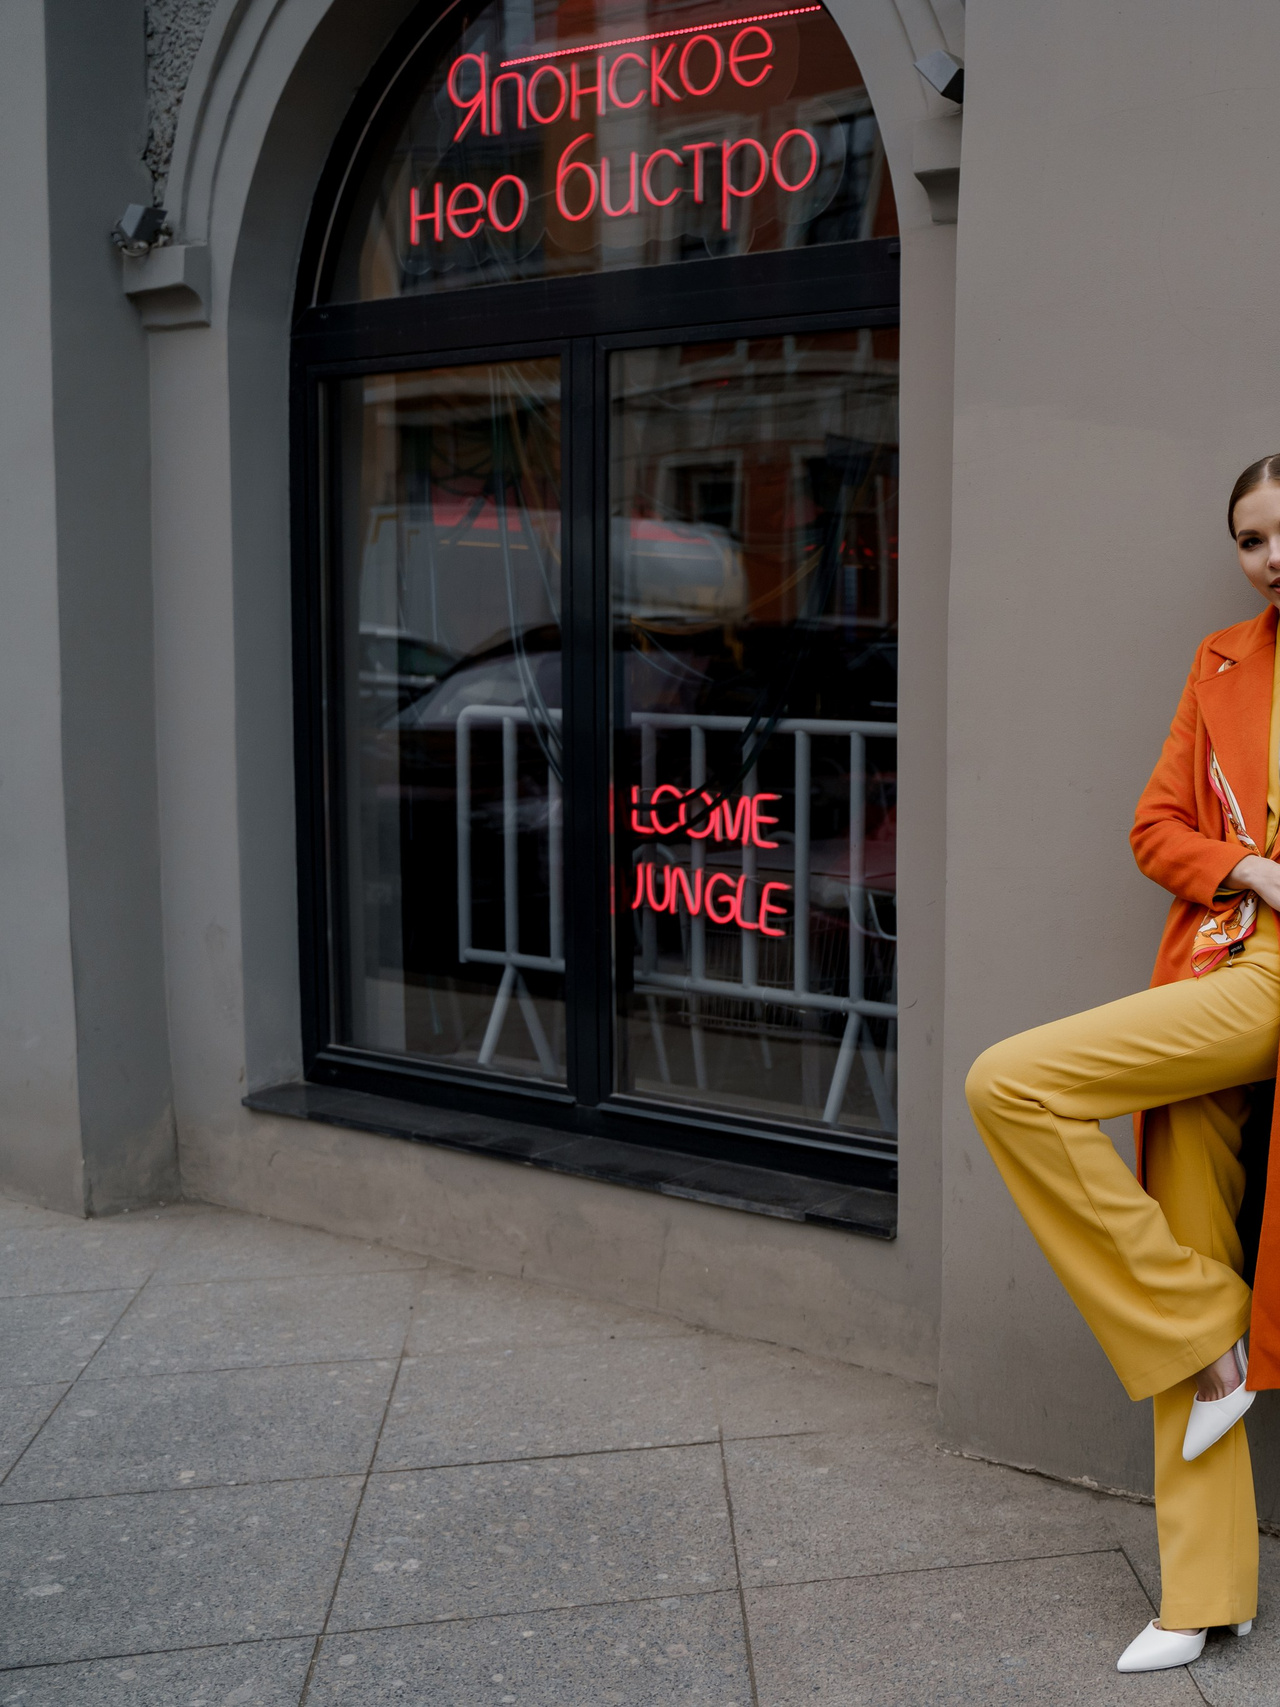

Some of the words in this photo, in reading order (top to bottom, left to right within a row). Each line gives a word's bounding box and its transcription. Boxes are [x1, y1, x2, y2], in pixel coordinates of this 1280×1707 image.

[448, 26, 774, 142] Японское
[410, 174, 529, 246] нео
[555, 128, 820, 231] бистро
[631, 862, 793, 937] JUNGLE
